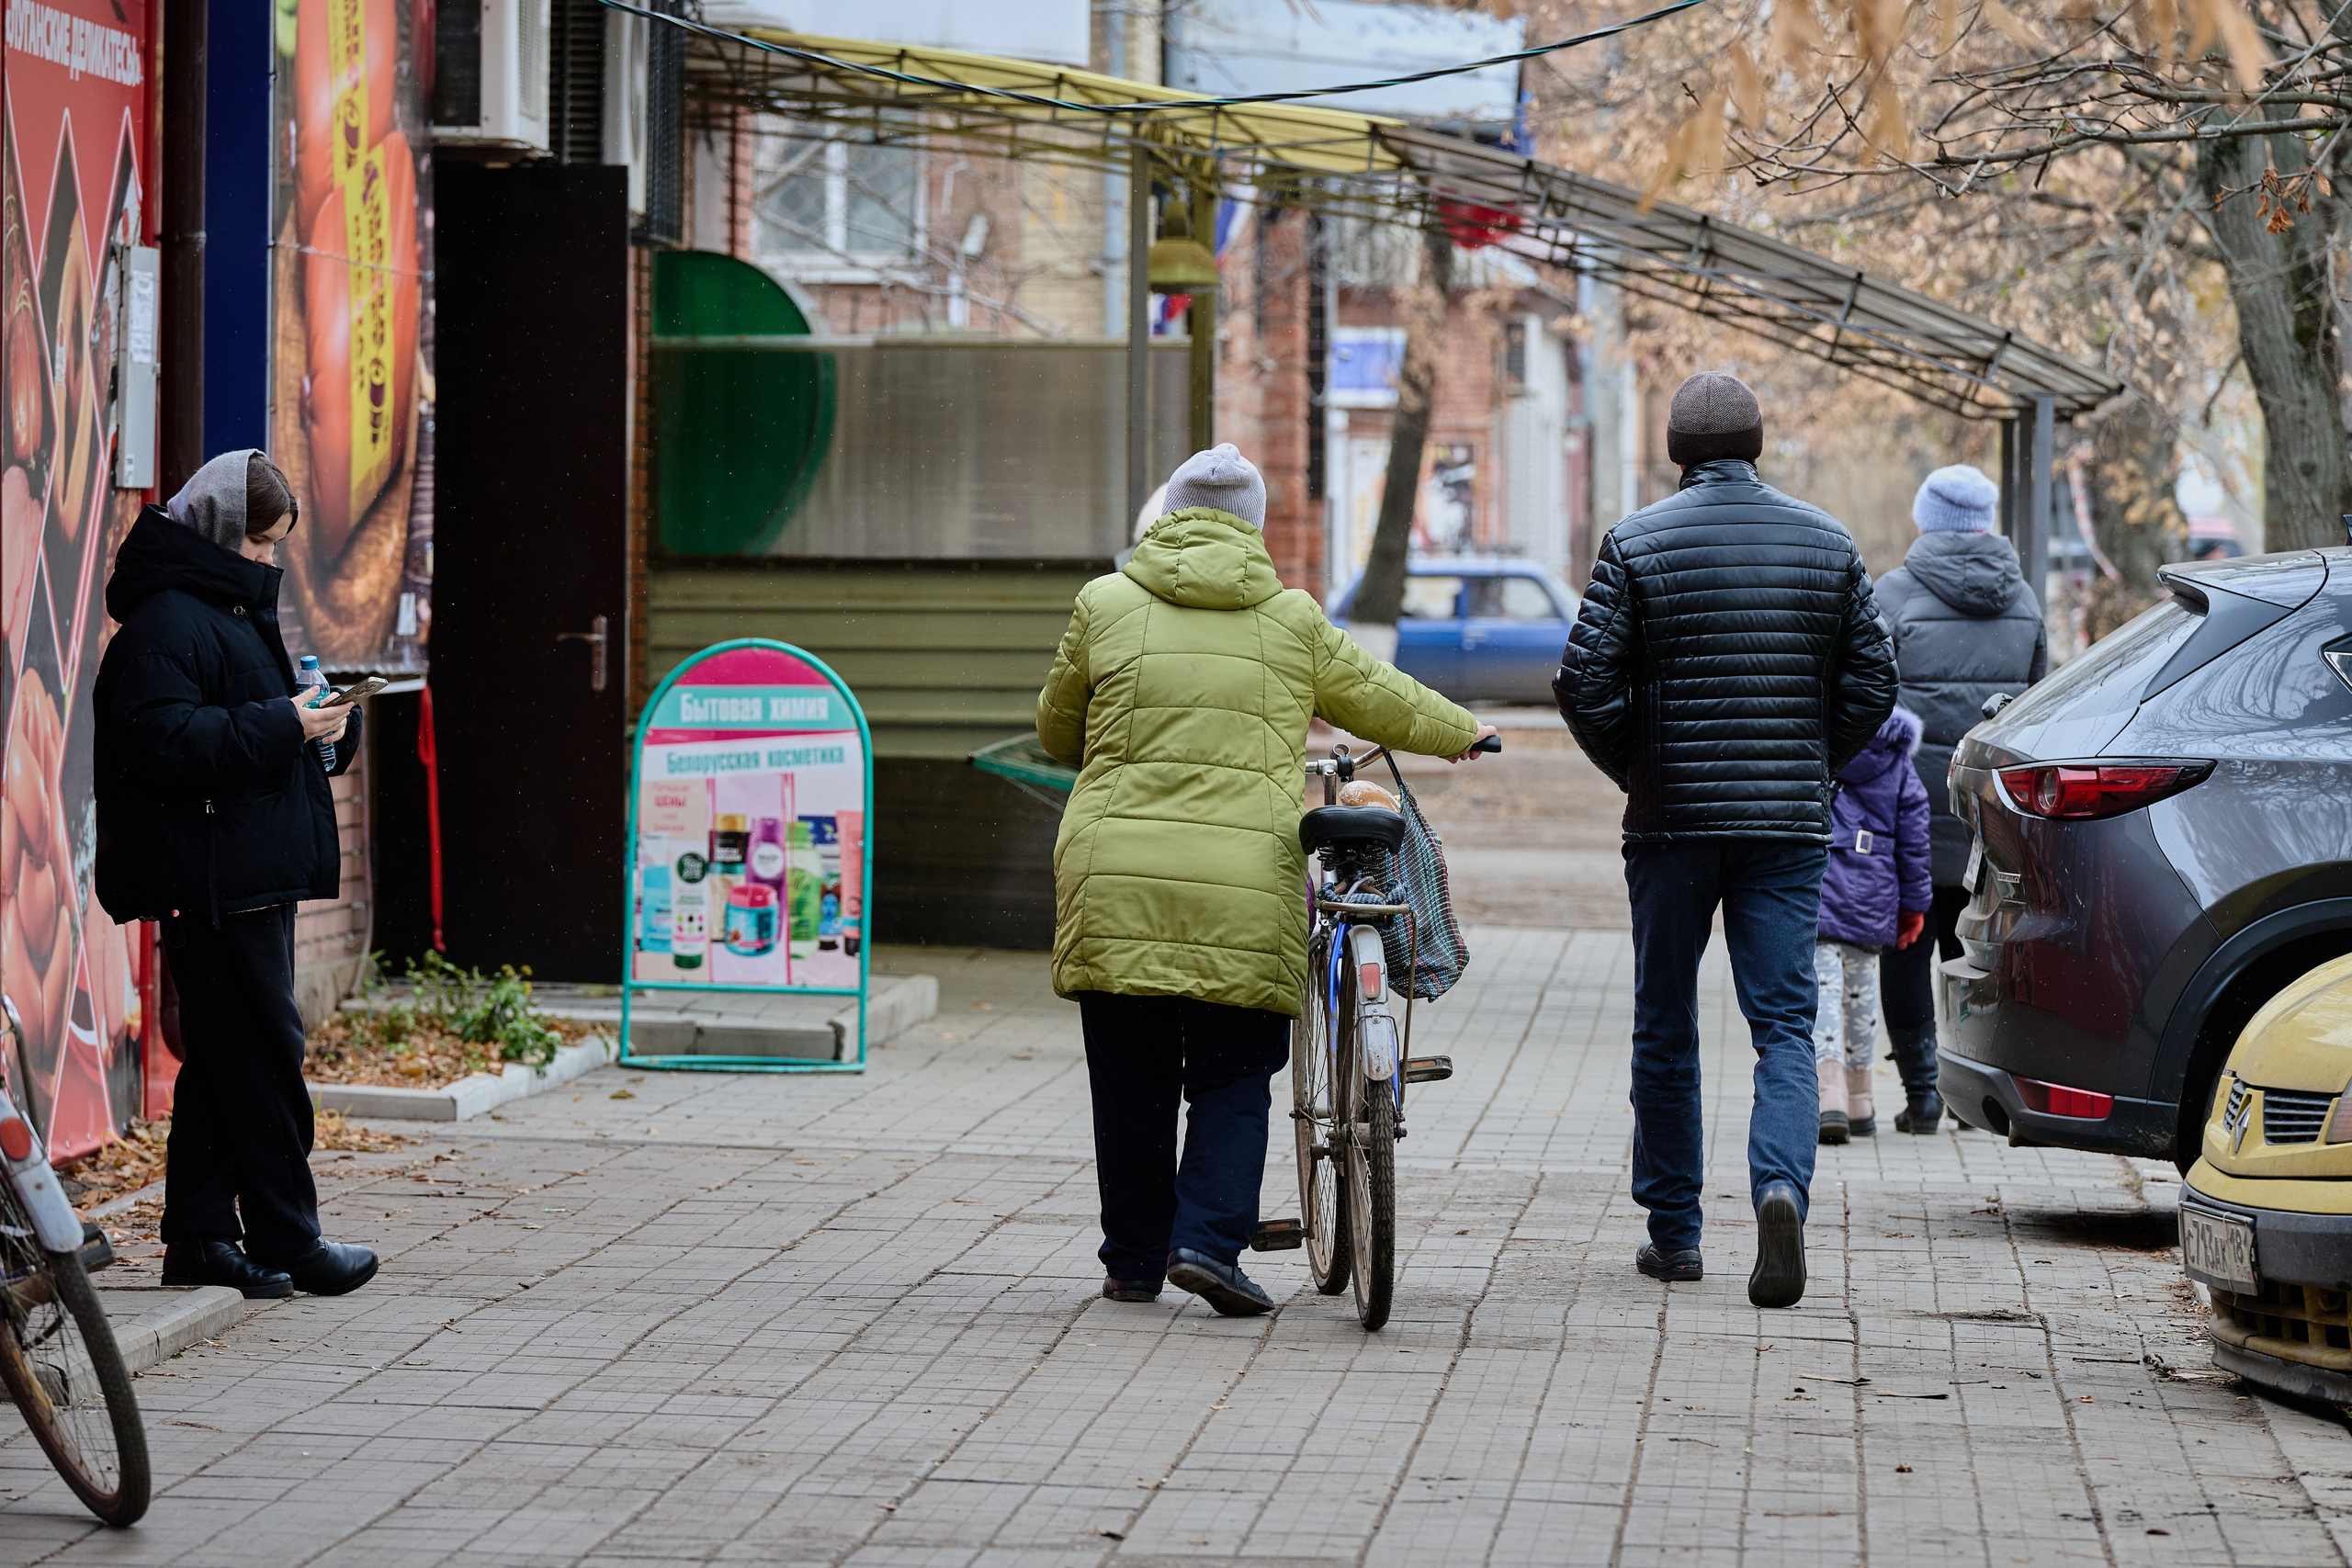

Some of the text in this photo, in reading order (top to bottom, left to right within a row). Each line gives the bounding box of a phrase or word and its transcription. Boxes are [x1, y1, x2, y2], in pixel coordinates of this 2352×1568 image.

[680, 693, 829, 723] Бытовая химия
[667, 746, 845, 775] Белорусская косметика
